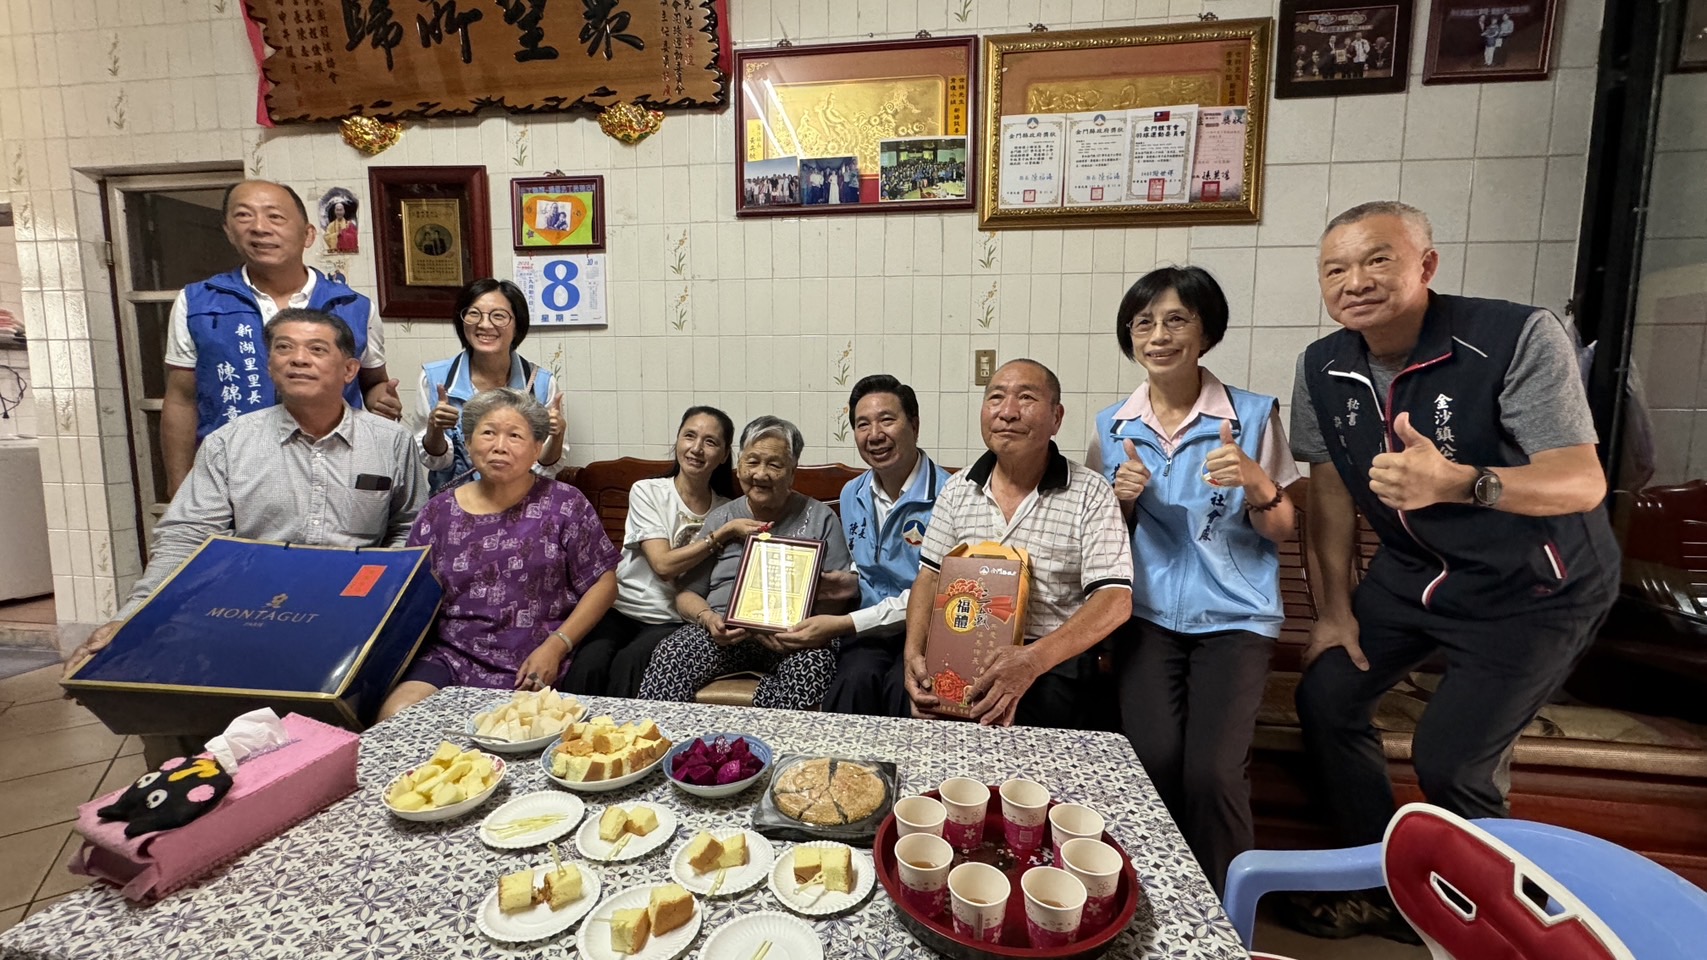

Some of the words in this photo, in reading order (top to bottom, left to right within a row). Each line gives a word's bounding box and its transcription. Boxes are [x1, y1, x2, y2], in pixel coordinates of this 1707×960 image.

[1075, 127, 1125, 135] 金門縣政府獎狀
[1136, 130, 1187, 138] 羽球運動委員會
[1143, 124, 1180, 132] 金門體育會
[1008, 131, 1057, 140] 金門縣政府獎狀
[541, 260, 581, 312] 8
[541, 314, 579, 323] 星期二
[234, 323, 262, 404] 新湖里里長
[1346, 397, 1361, 427] 秘書
[1434, 393, 1458, 464] 金沙鎮公
[205, 606, 319, 625] MONTAGUT
